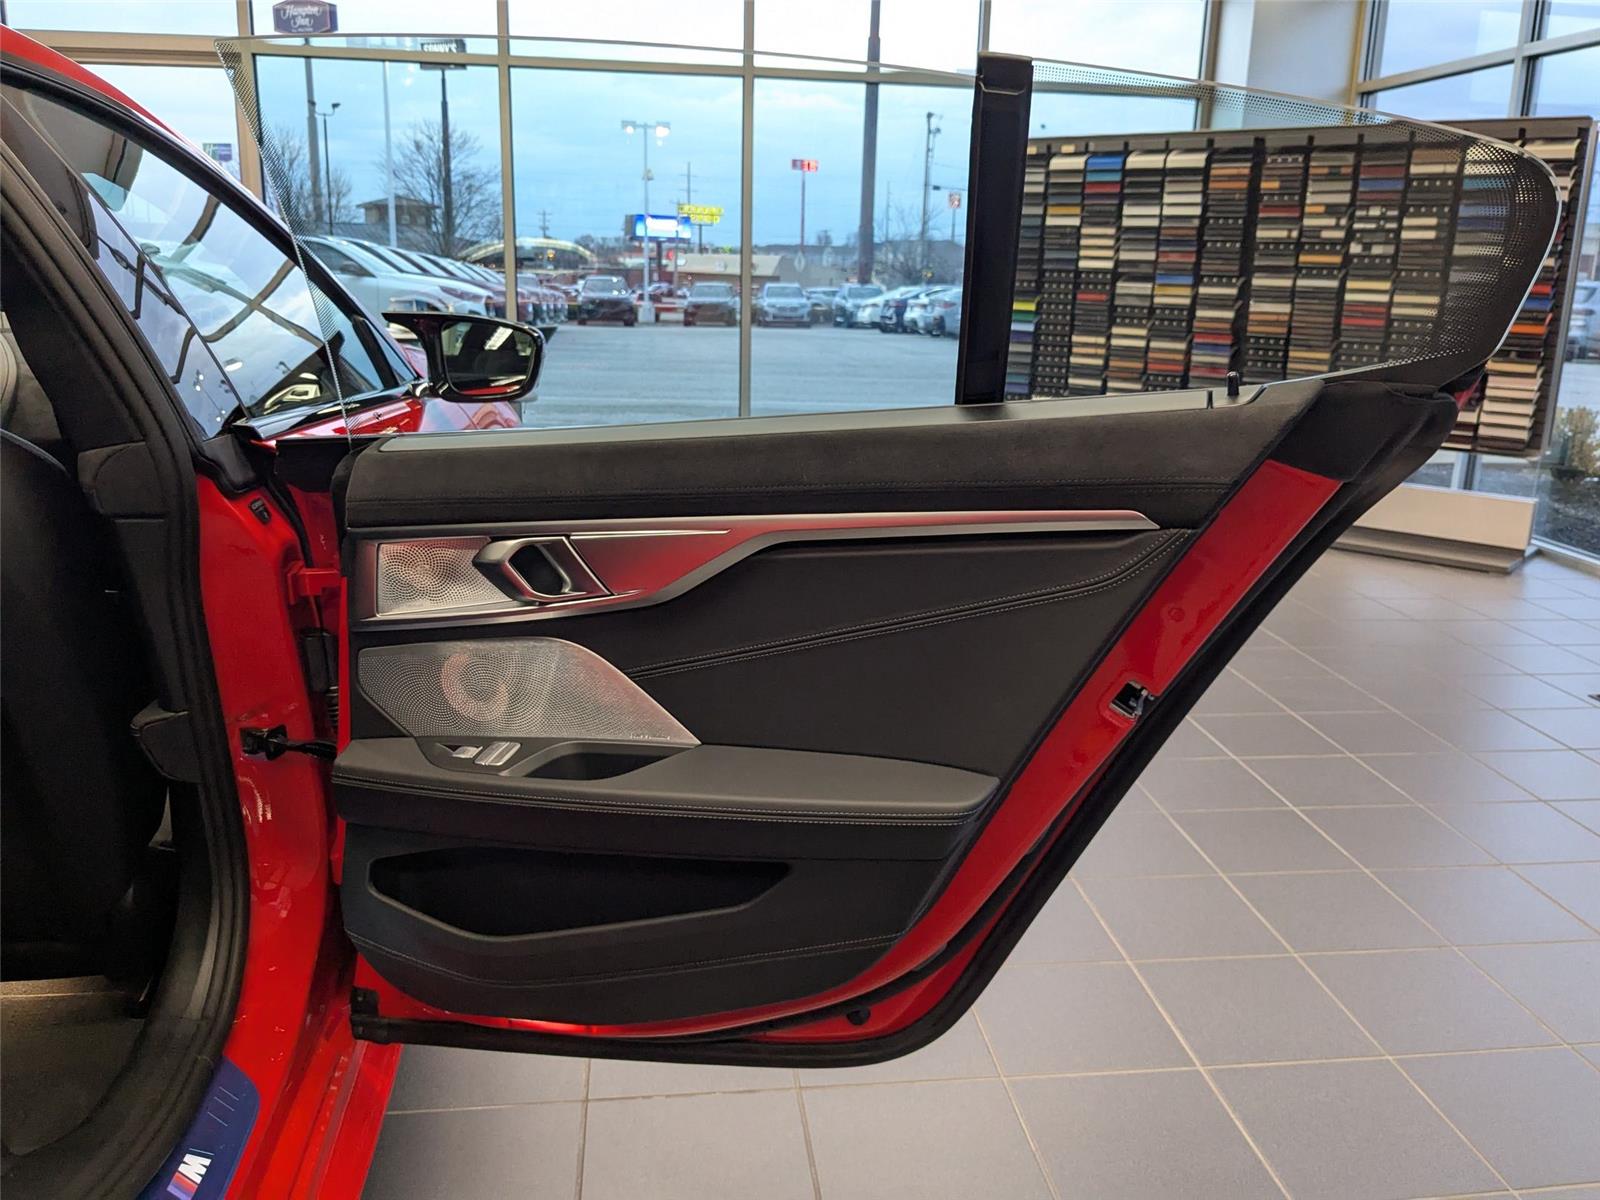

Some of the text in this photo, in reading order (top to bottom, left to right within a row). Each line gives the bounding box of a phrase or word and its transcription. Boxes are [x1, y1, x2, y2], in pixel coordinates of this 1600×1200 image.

[280, 5, 322, 19] Hampton
[290, 16, 314, 28] Inn
[177, 1153, 212, 1185] M
